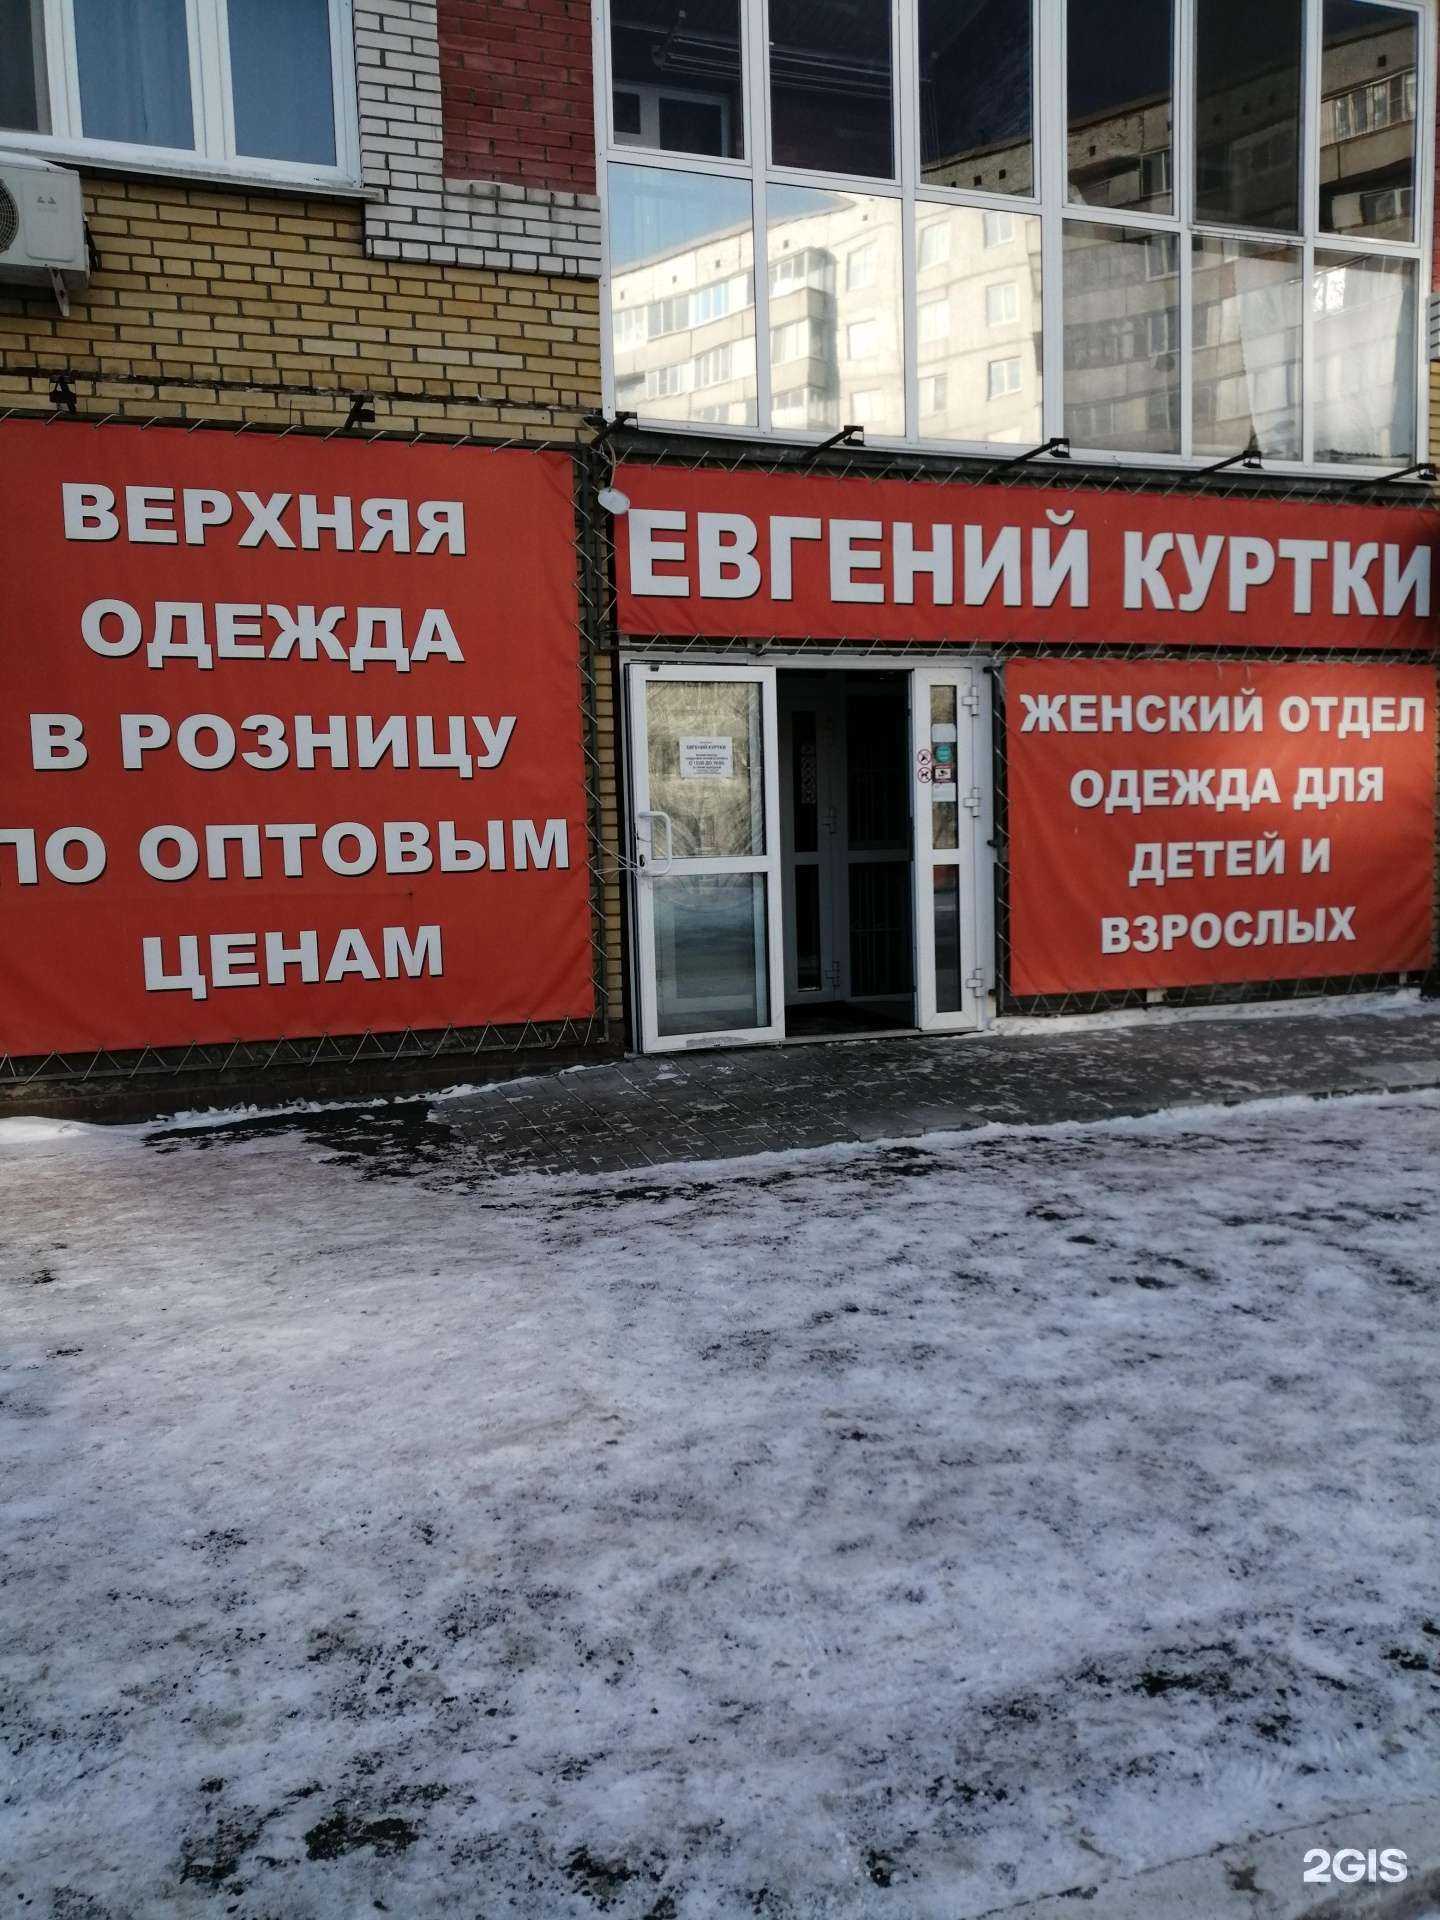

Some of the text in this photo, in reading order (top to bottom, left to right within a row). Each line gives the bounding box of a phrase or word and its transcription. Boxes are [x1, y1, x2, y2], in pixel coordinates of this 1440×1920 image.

[61, 482, 466, 555] ВЕРХНЯЯ
[628, 508, 1431, 617] ЕВГЕНИЙ КУРТКИ
[81, 599, 465, 671] ОДЕЖДА
[1019, 687, 1426, 740] ЖЕНСКИЙ ОТДЕЛ
[30, 713, 517, 778] В РОЗНИЦУ
[1070, 766, 1385, 814] ОДЕЖДА ДЛЯ
[139, 819, 569, 881] ОПТОВЫМ
[1128, 830, 1331, 887] ДЕТЕЙ И
[1101, 906, 1356, 954] ВЗРОСЛЫХ
[142, 925, 443, 1000] ЦЕНАМ
